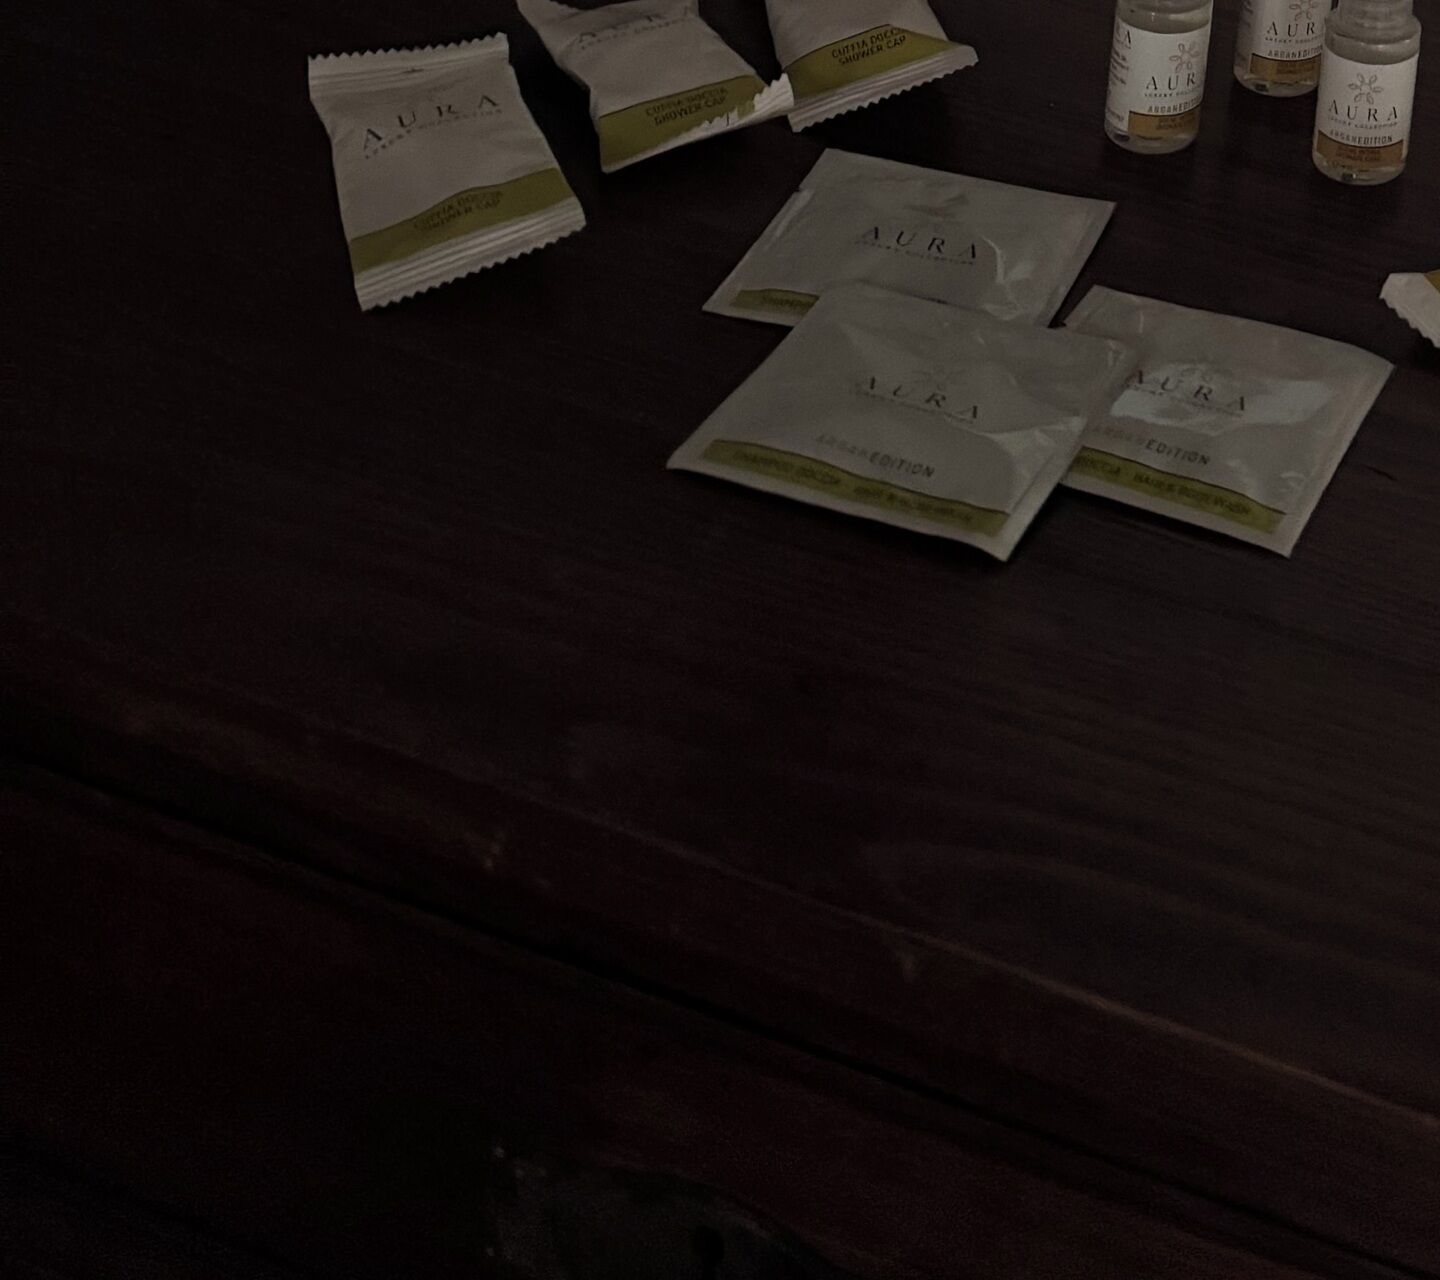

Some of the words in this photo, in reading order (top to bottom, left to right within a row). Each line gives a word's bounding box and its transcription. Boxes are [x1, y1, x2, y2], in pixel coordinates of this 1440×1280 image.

[870, 27, 902, 45] DOCC
[1265, 21, 1316, 38] AUR
[838, 46, 884, 66] SHOWER
[886, 35, 907, 49] CAP
[1145, 72, 1197, 91] AUR
[364, 95, 499, 151] AURA
[1328, 99, 1398, 122] AURA
[861, 226, 977, 259] AURA
[853, 376, 979, 419] AURA
[1124, 369, 1246, 412] AURA
